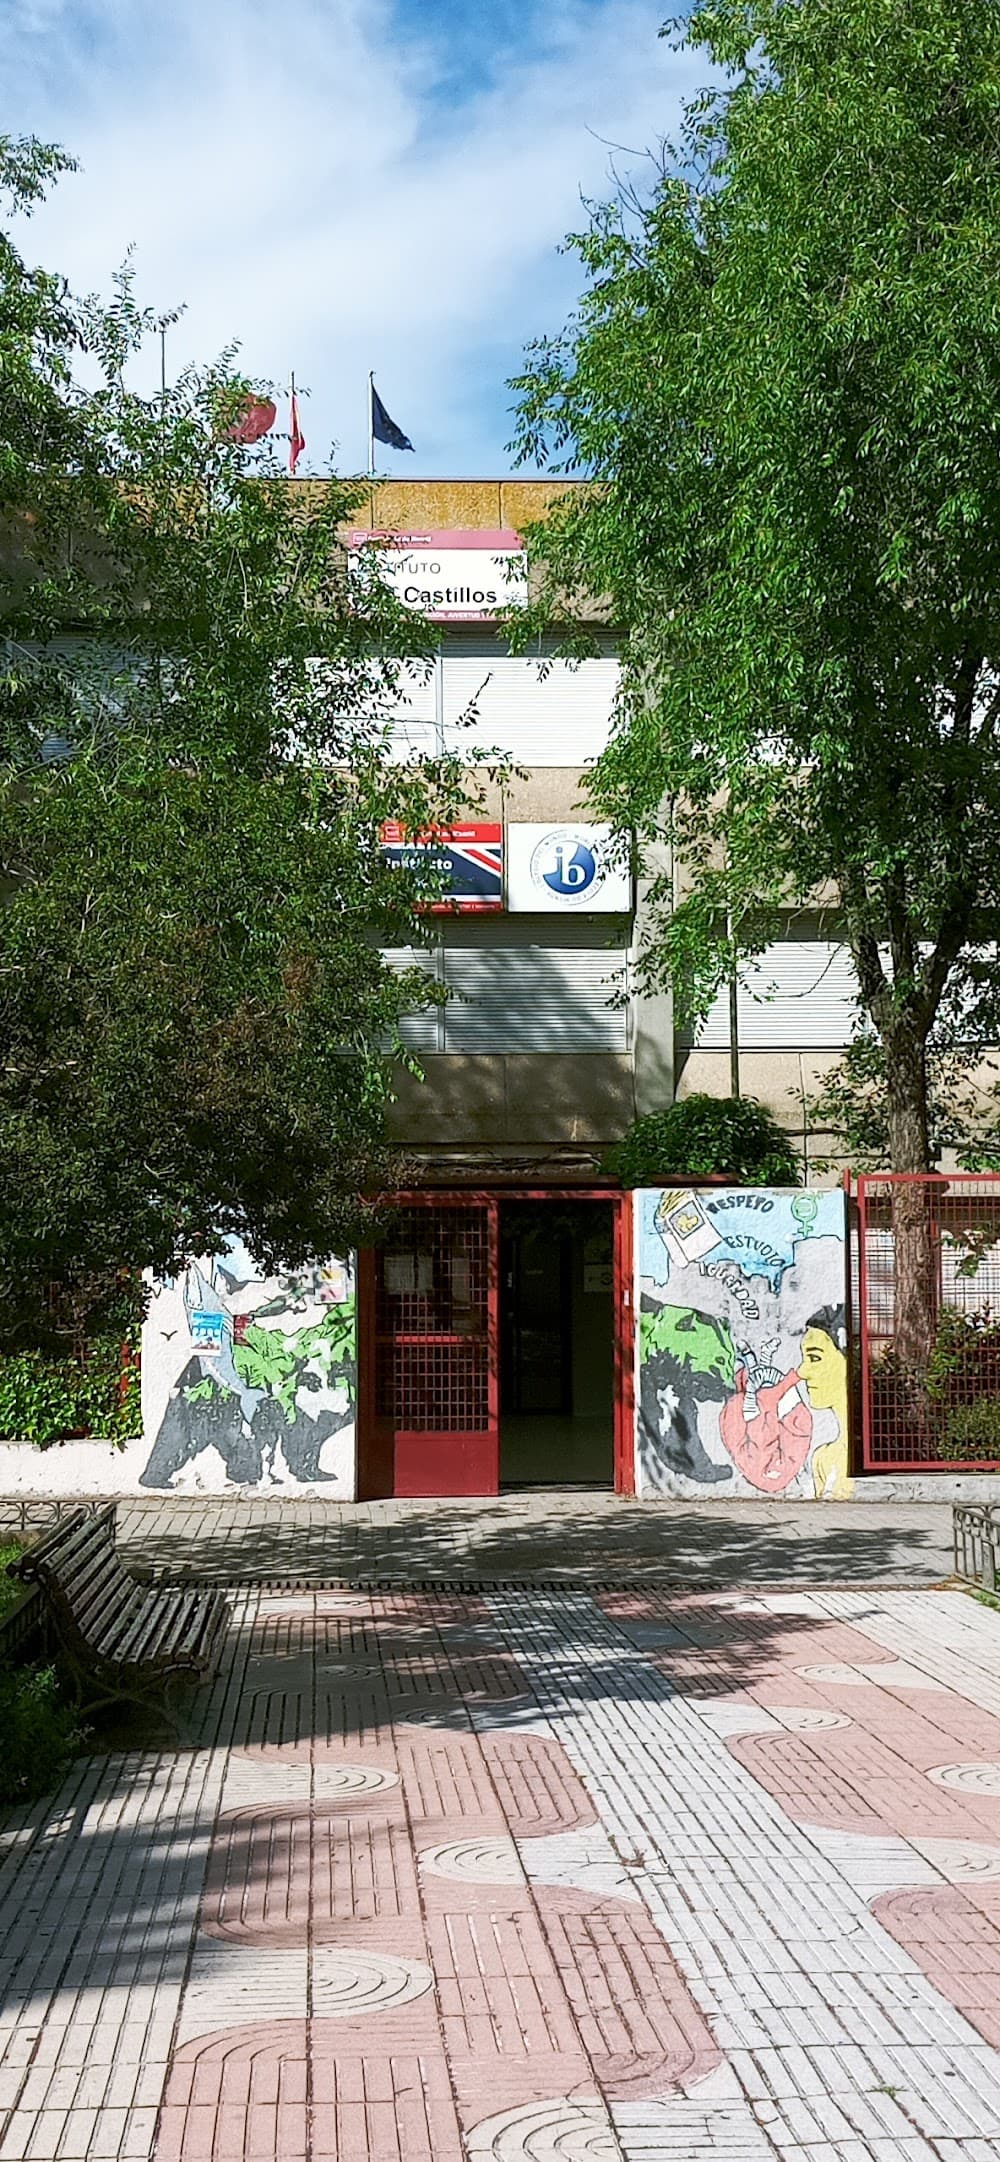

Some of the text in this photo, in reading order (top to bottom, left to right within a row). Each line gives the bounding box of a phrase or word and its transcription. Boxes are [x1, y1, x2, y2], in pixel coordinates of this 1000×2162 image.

[404, 586, 497, 603] Castillos
[723, 1234, 786, 1267] ESTUDIO
[699, 1261, 760, 1320] IGUALDAD
